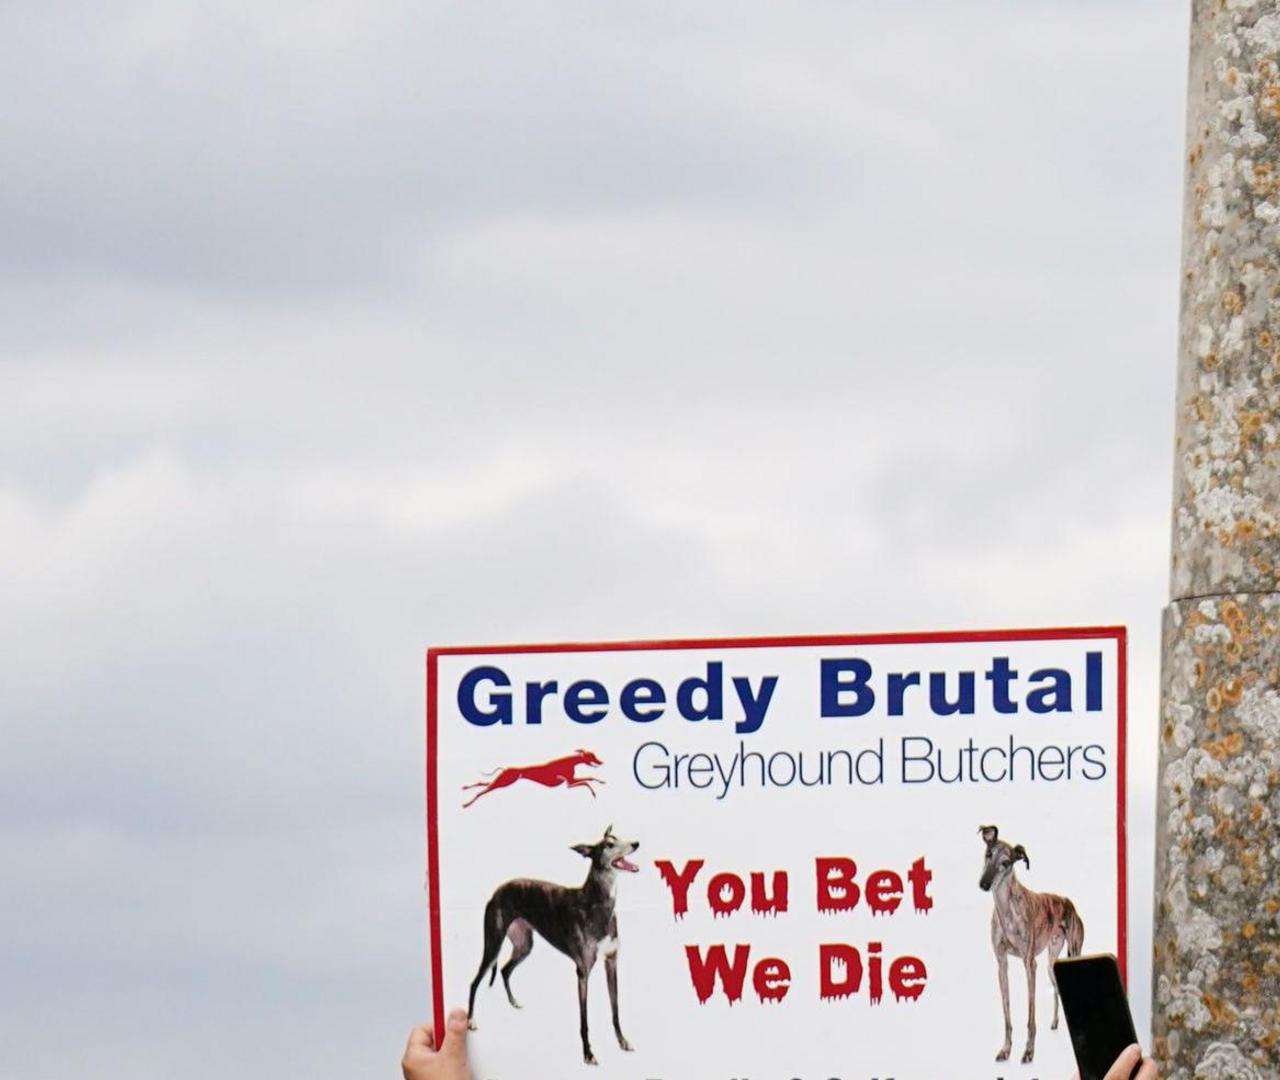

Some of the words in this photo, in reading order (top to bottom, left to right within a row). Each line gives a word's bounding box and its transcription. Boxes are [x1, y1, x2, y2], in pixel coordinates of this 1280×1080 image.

[457, 661, 778, 733] Greedy
[820, 652, 1103, 718] Brutal
[633, 738, 883, 799] Greyhound
[902, 736, 1106, 784] Butchers
[655, 859, 789, 920] You
[816, 857, 933, 914] Bet
[685, 944, 791, 1005] We
[819, 942, 927, 1004] Die
